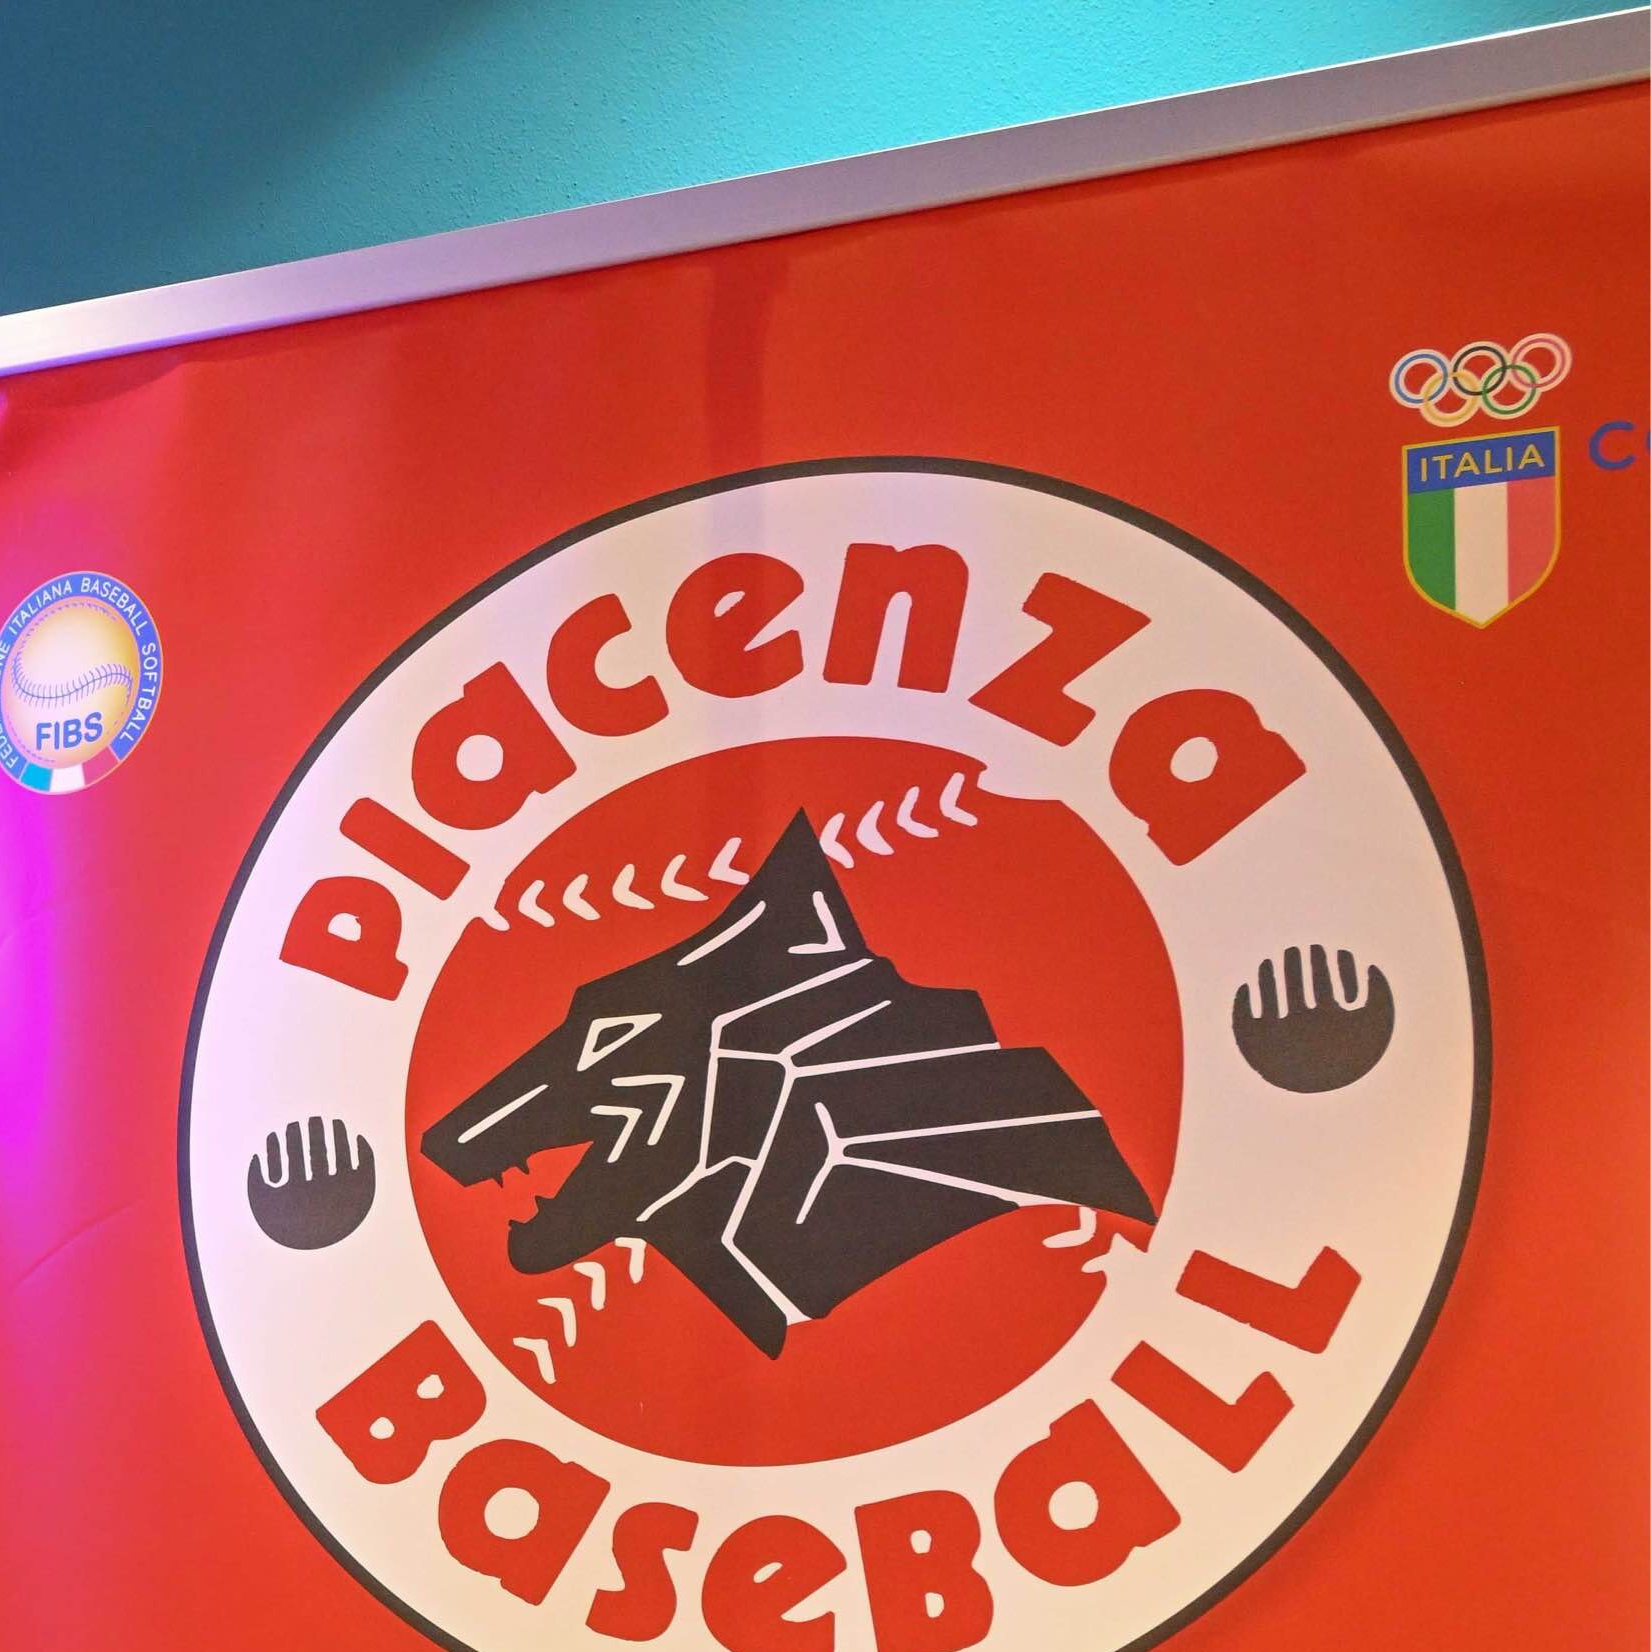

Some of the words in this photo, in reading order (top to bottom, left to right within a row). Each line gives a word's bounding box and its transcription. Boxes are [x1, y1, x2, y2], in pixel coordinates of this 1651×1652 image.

[1419, 444, 1546, 482] ITALIA
[1588, 420, 1651, 471] C
[8, 579, 73, 636] ITALIANA
[80, 577, 150, 637] BASEBALL
[119, 642, 159, 743] SOFTBALL
[35, 711, 103, 751] FIBS
